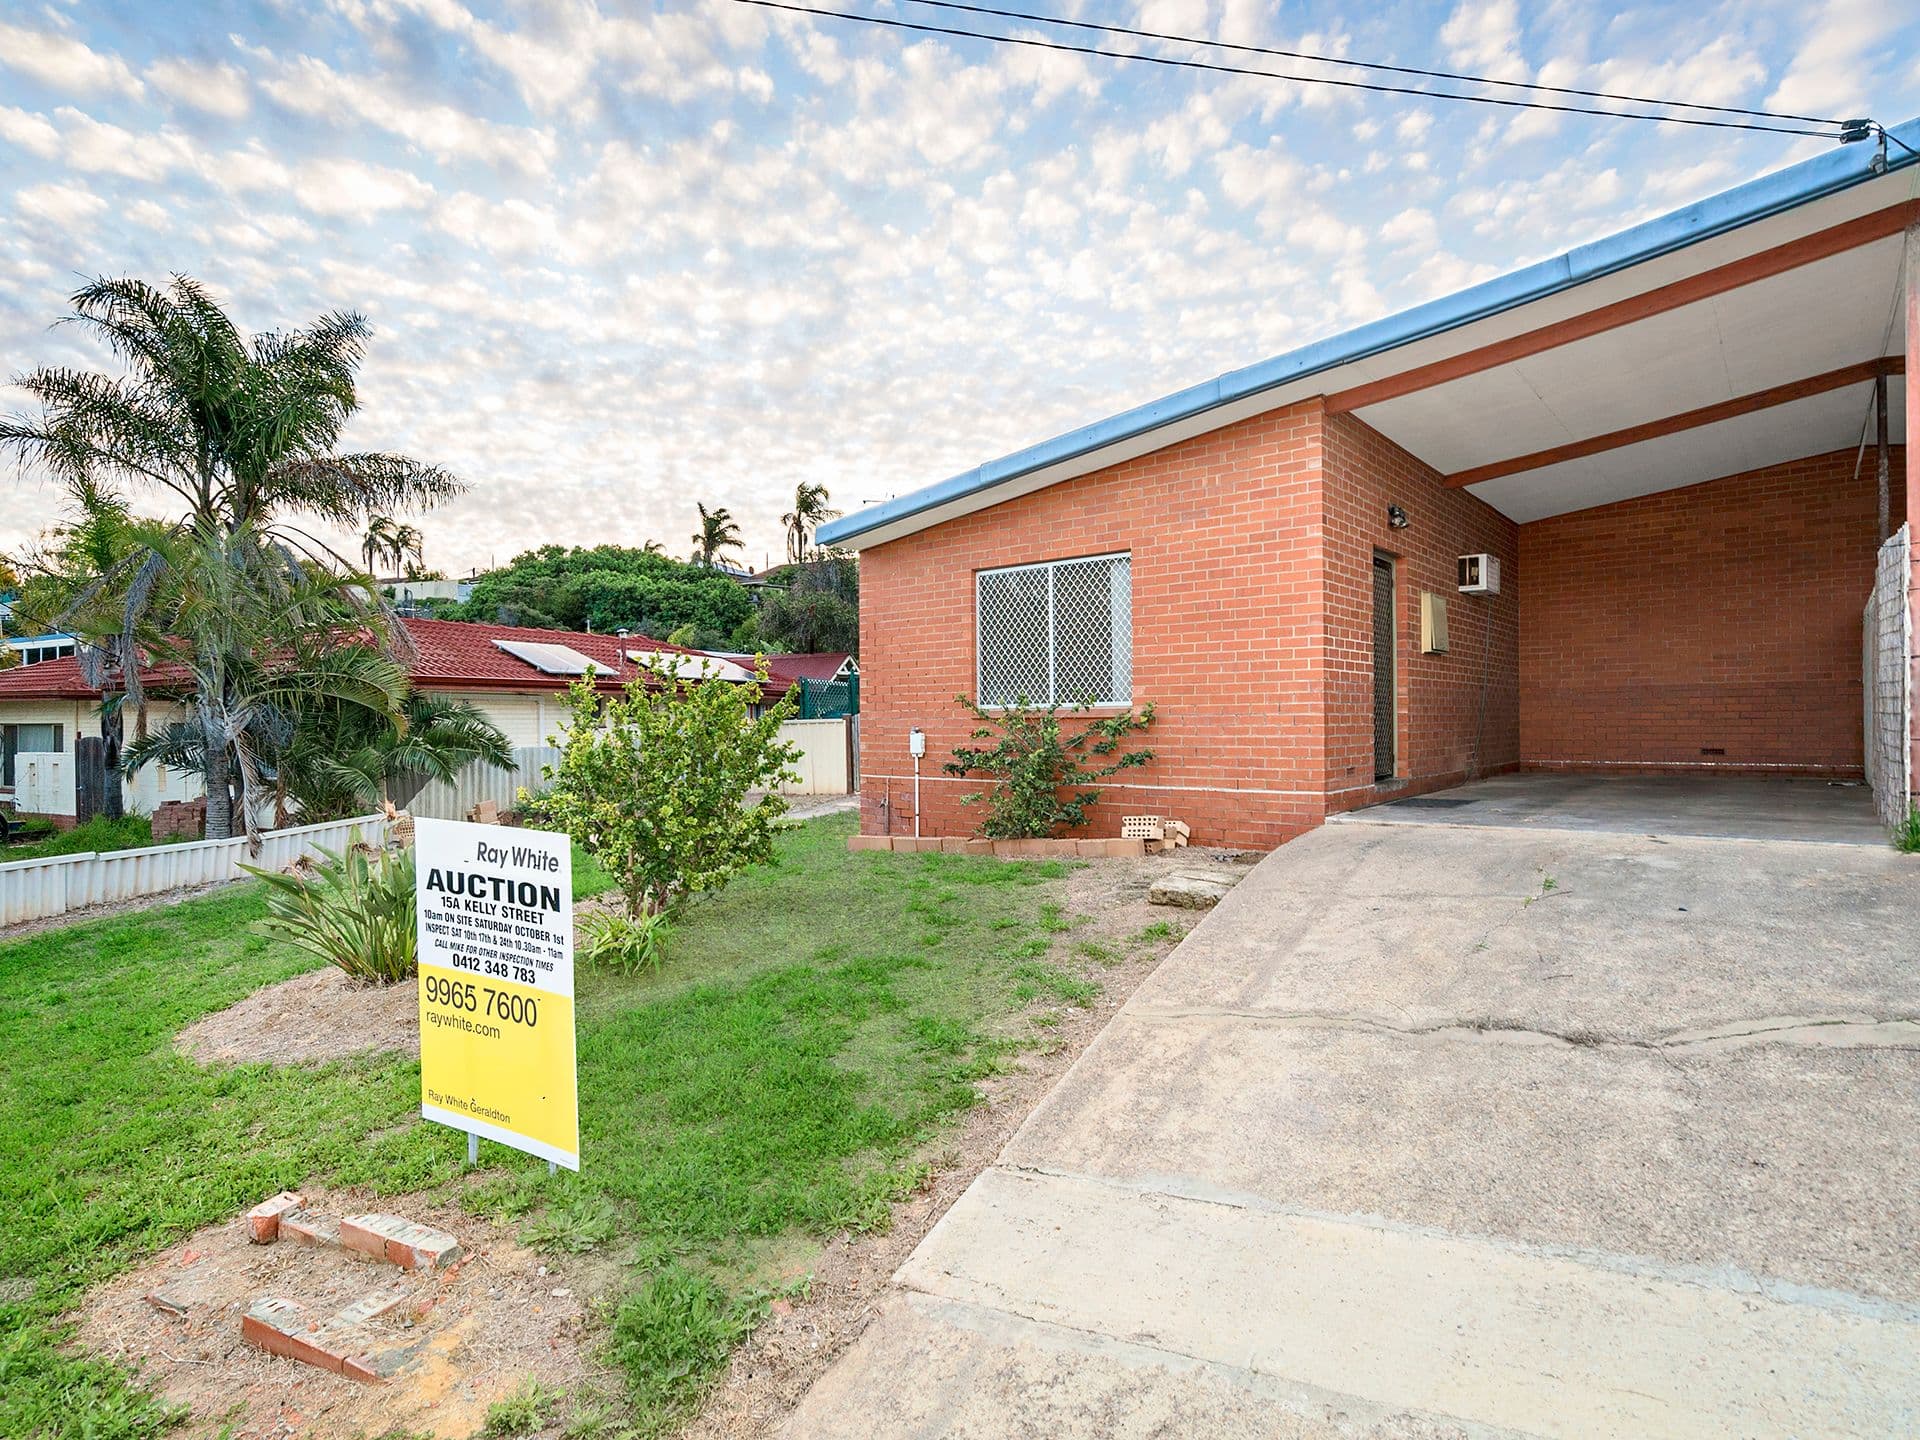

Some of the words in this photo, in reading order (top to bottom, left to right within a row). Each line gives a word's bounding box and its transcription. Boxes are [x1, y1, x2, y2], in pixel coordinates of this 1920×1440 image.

[477, 841, 508, 868] Ray
[512, 847, 559, 872] White
[426, 868, 560, 912] AUCTION
[441, 896, 460, 909] 15A
[465, 899, 496, 916] KELLY
[502, 906, 544, 925] STREET
[424, 910, 442, 921] 10am
[445, 913, 454, 922] ON
[457, 915, 472, 926] SITE
[475, 918, 512, 935] SATURDAY
[515, 925, 550, 942] OCTOBER
[553, 935, 564, 945] 1st
[425, 923, 449, 935] INSPECT
[451, 927, 462, 938] SAT
[464, 930, 477, 940] 10th
[479, 933, 491, 943] 17th
[493, 936, 497, 944] &
[500, 937, 513, 948] 24th
[548, 947, 563, 959] 11am
[435, 939, 448, 950] CALL
[450, 942, 464, 952] MIKE
[466, 945, 477, 954] FOR
[479, 947, 497, 959] OTHER
[500, 952, 534, 968] INSPECTION
[536, 960, 553, 971] TIMES
[453, 953, 480, 971] 0412
[485, 960, 508, 977] 348
[513, 966, 535, 983] 783
[426, 976, 477, 1012] 9965
[483, 988, 537, 1027] 7600
[426, 1011, 500, 1039] raywhite.com
[428, 1089, 443, 1104] Ray
[445, 1095, 468, 1111] White
[470, 1102, 510, 1123] Geraldton
